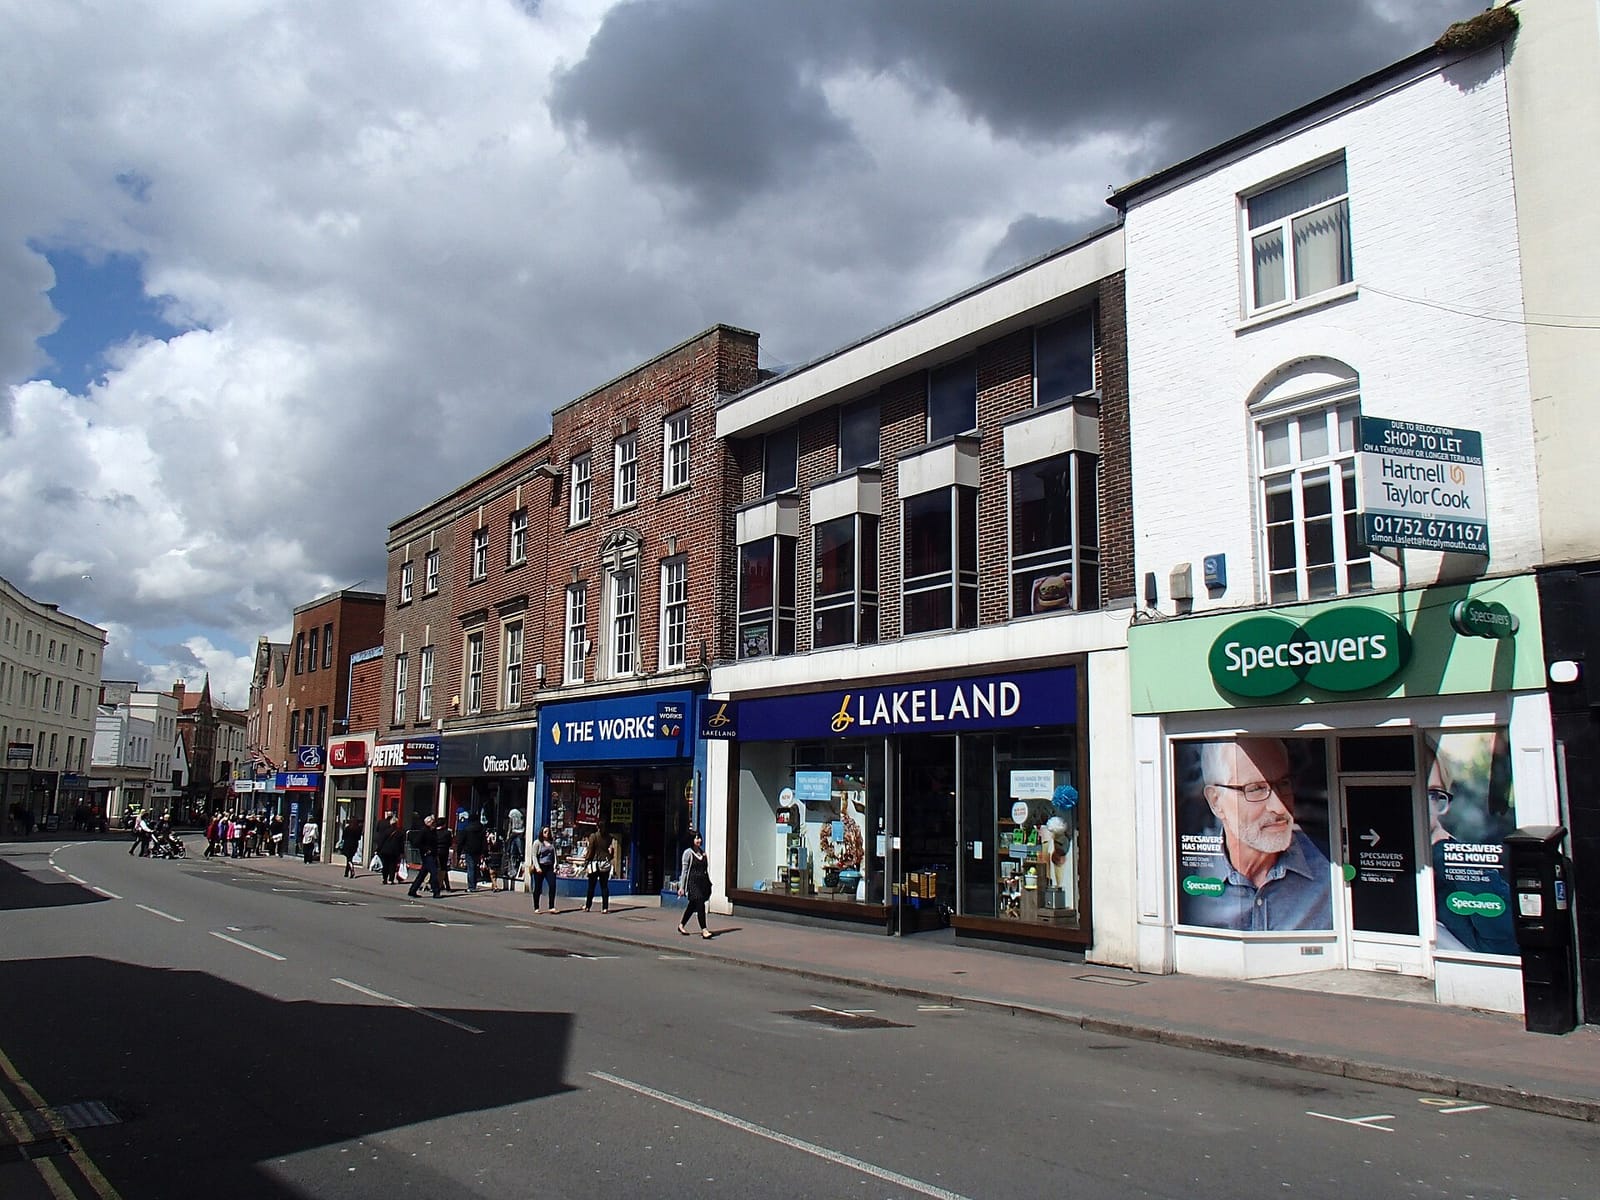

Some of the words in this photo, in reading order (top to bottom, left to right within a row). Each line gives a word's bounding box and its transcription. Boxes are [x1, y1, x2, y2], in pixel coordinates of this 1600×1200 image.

[1391, 421, 1404, 430] DUE
[1406, 422, 1415, 431] TO
[1416, 424, 1454, 436] RELOCATION
[1384, 430, 1417, 447] SHOP
[1419, 434, 1436, 450] TO
[1440, 437, 1462, 453] LET
[1364, 443, 1373, 451] ON
[1380, 446, 1414, 456] TEMPORARY
[1415, 449, 1424, 457] OR
[1425, 451, 1449, 460] LONGER
[1450, 454, 1466, 462] TERM
[1467, 457, 1481, 465] BASIS
[1382, 458, 1445, 483] Hartnell
[1382, 482, 1429, 508] Taylor
[1431, 487, 1471, 509] Cook
[1374, 516, 1422, 536] 01752
[1428, 520, 1482, 541] 671167
[1469, 607, 1509, 625] Specsavers
[1224, 635, 1387, 677] Specsavers
[859, 682, 1020, 726] LAKELAND
[565, 720, 594, 742] THE
[598, 716, 654, 740] WORKS
[373, 743, 408, 767] BETFRE
[483, 755, 509, 772] Officers
[1182, 835, 1224, 844] SPECSAVERS
[1443, 842, 1503, 853] SPECSAVERS
[1360, 852, 1403, 860] SPECSAVERS
[1444, 852, 1464, 861] HAS
[1465, 853, 1499, 863] MOVED
[1187, 880, 1222, 891] Specsavers
[1452, 897, 1502, 910] Specsavers
